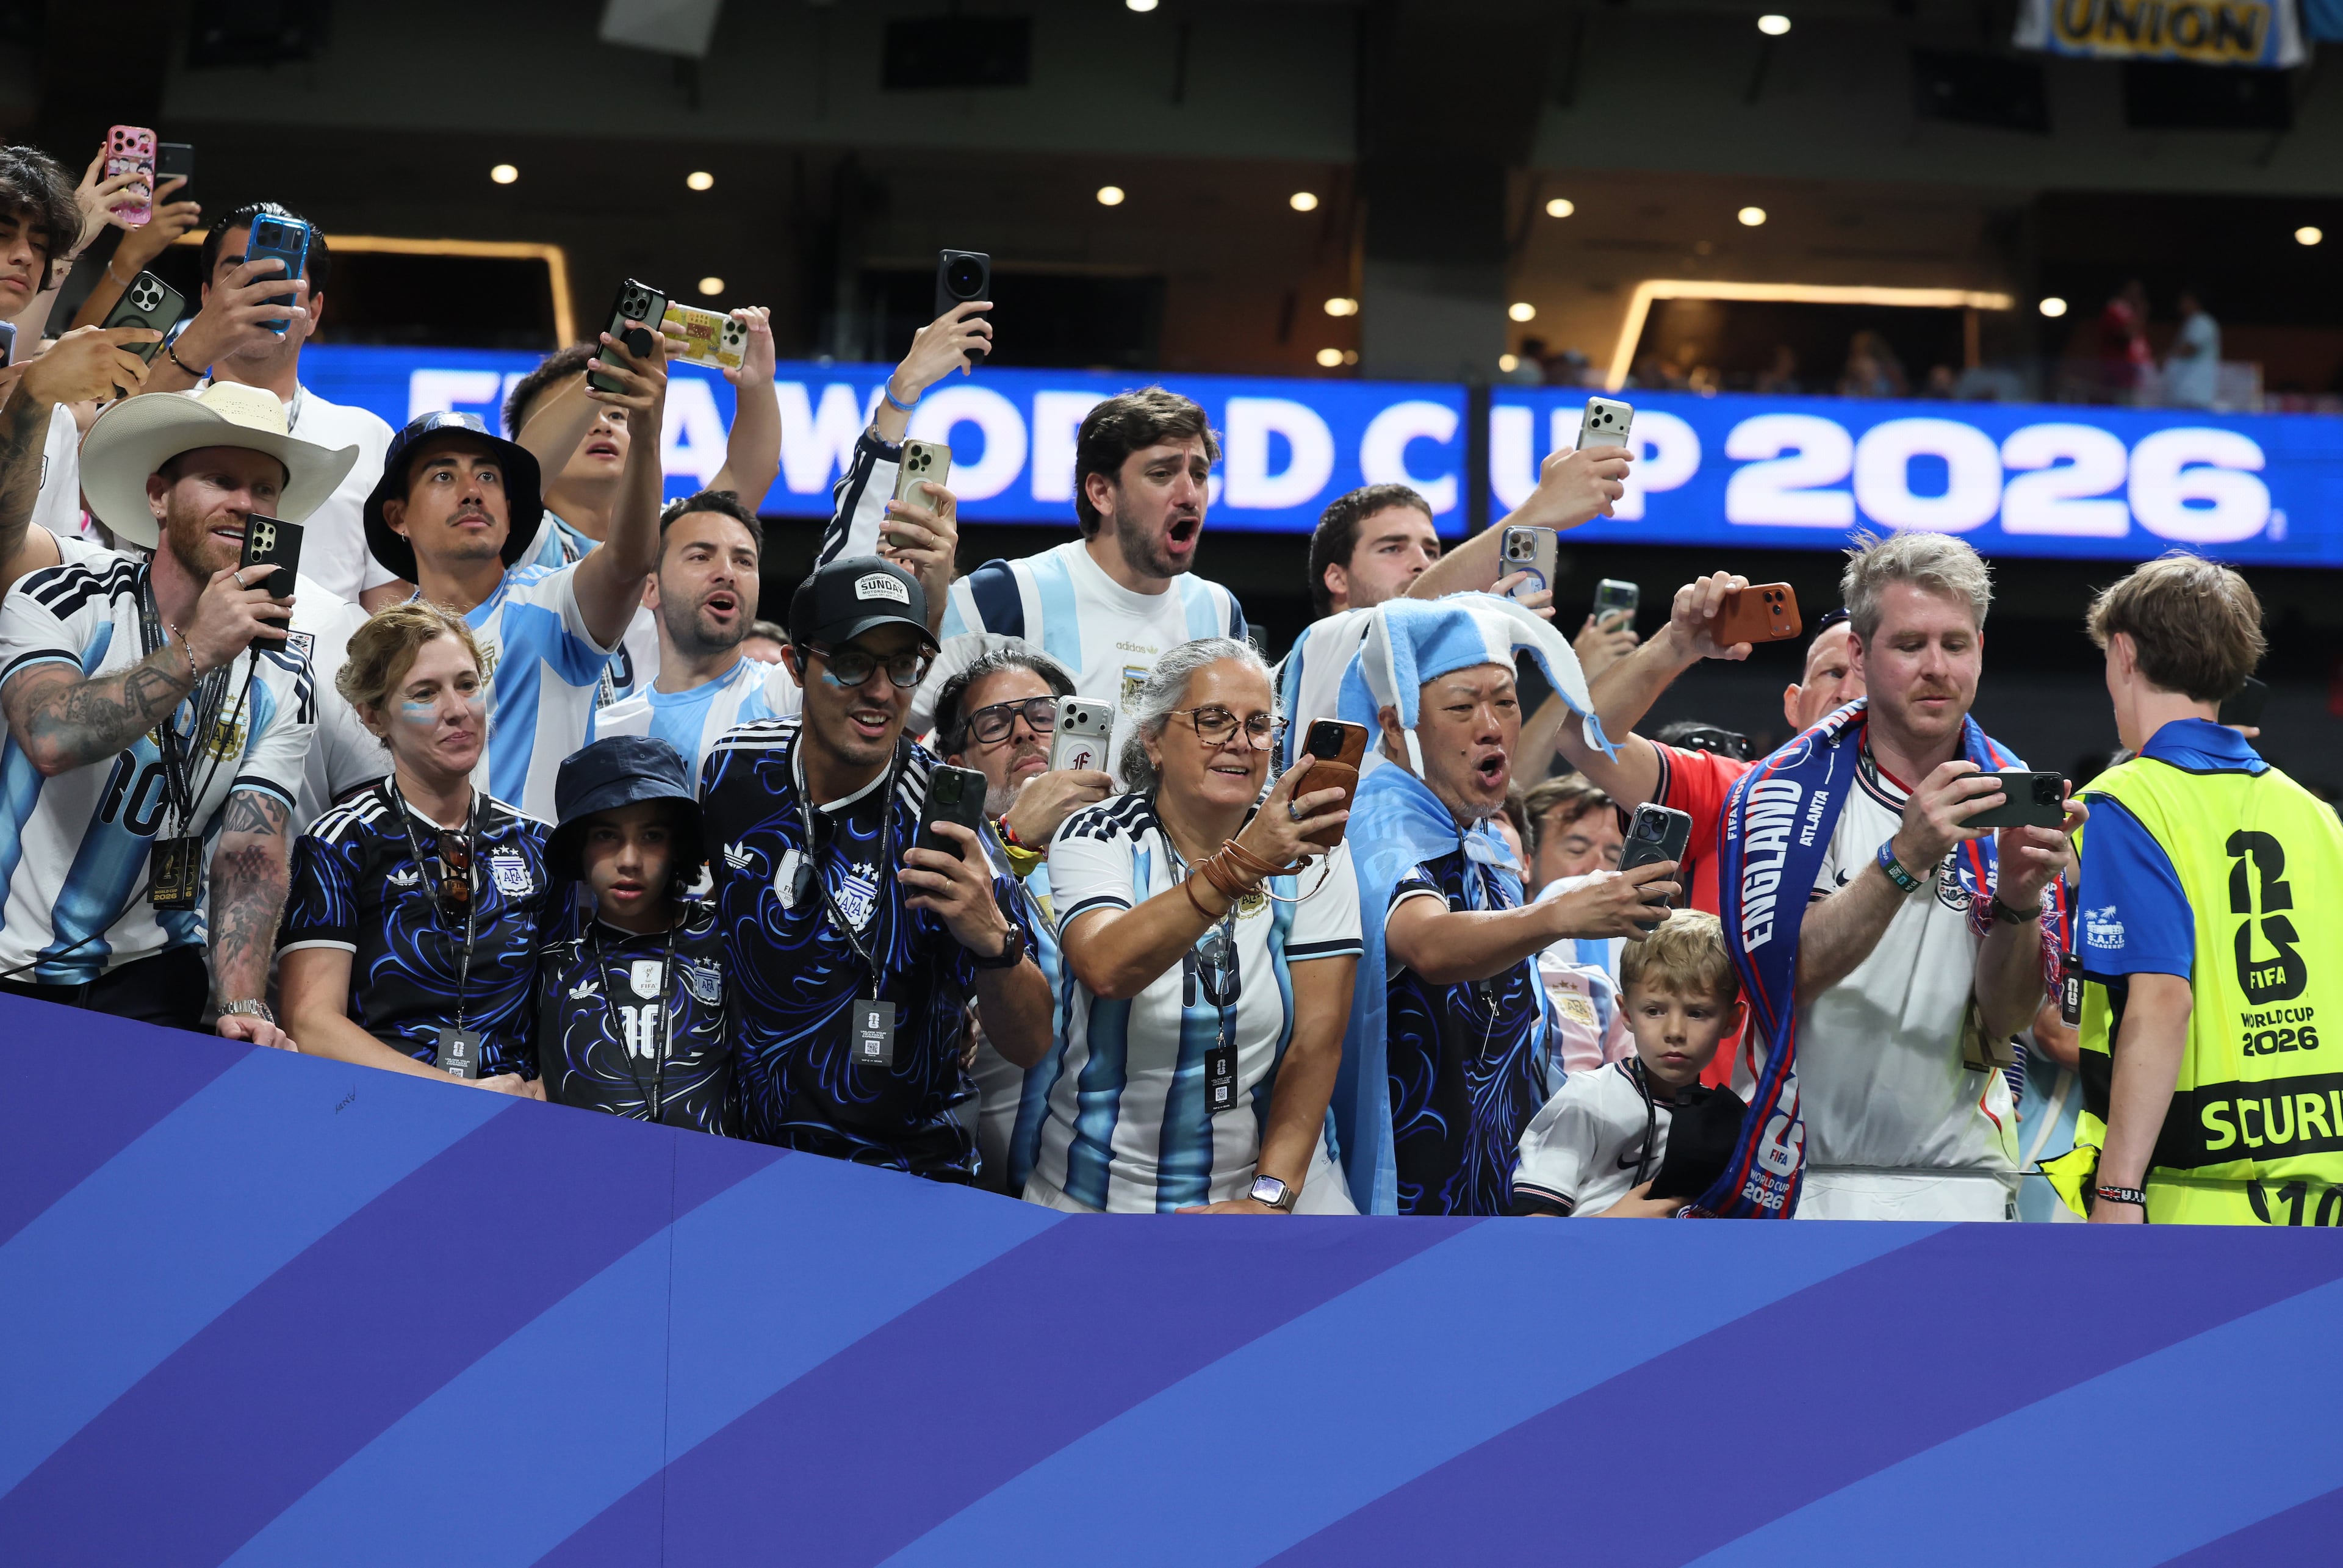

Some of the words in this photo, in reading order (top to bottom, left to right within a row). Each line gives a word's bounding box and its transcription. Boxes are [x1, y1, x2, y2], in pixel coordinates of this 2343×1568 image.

[2060, 0, 2261, 52] UNION
[1360, 400, 1701, 520] CUP
[1726, 414, 2272, 543] 2026
[861, 580, 903, 594] SUNDAY
[1116, 641, 1146, 654] adidas
[1727, 807, 1738, 841] FIFA
[1799, 789, 1829, 847] ATLANTA
[504, 868, 524, 885] AFA
[1742, 778, 1803, 954] ENGLAND
[840, 891, 861, 918] AFA
[702, 978, 714, 993] AFA
[2250, 966, 2287, 990] FIFA
[2240, 1009, 2283, 1029] WORLD
[2283, 1006, 2314, 1024] CUP
[2242, 1026, 2319, 1057] 2026
[1769, 1148, 1788, 1167] FIFA
[1750, 1168, 1775, 1189] WORLD
[1774, 1181, 1790, 1193] CUP
[1741, 1181, 1785, 1210] 2026
